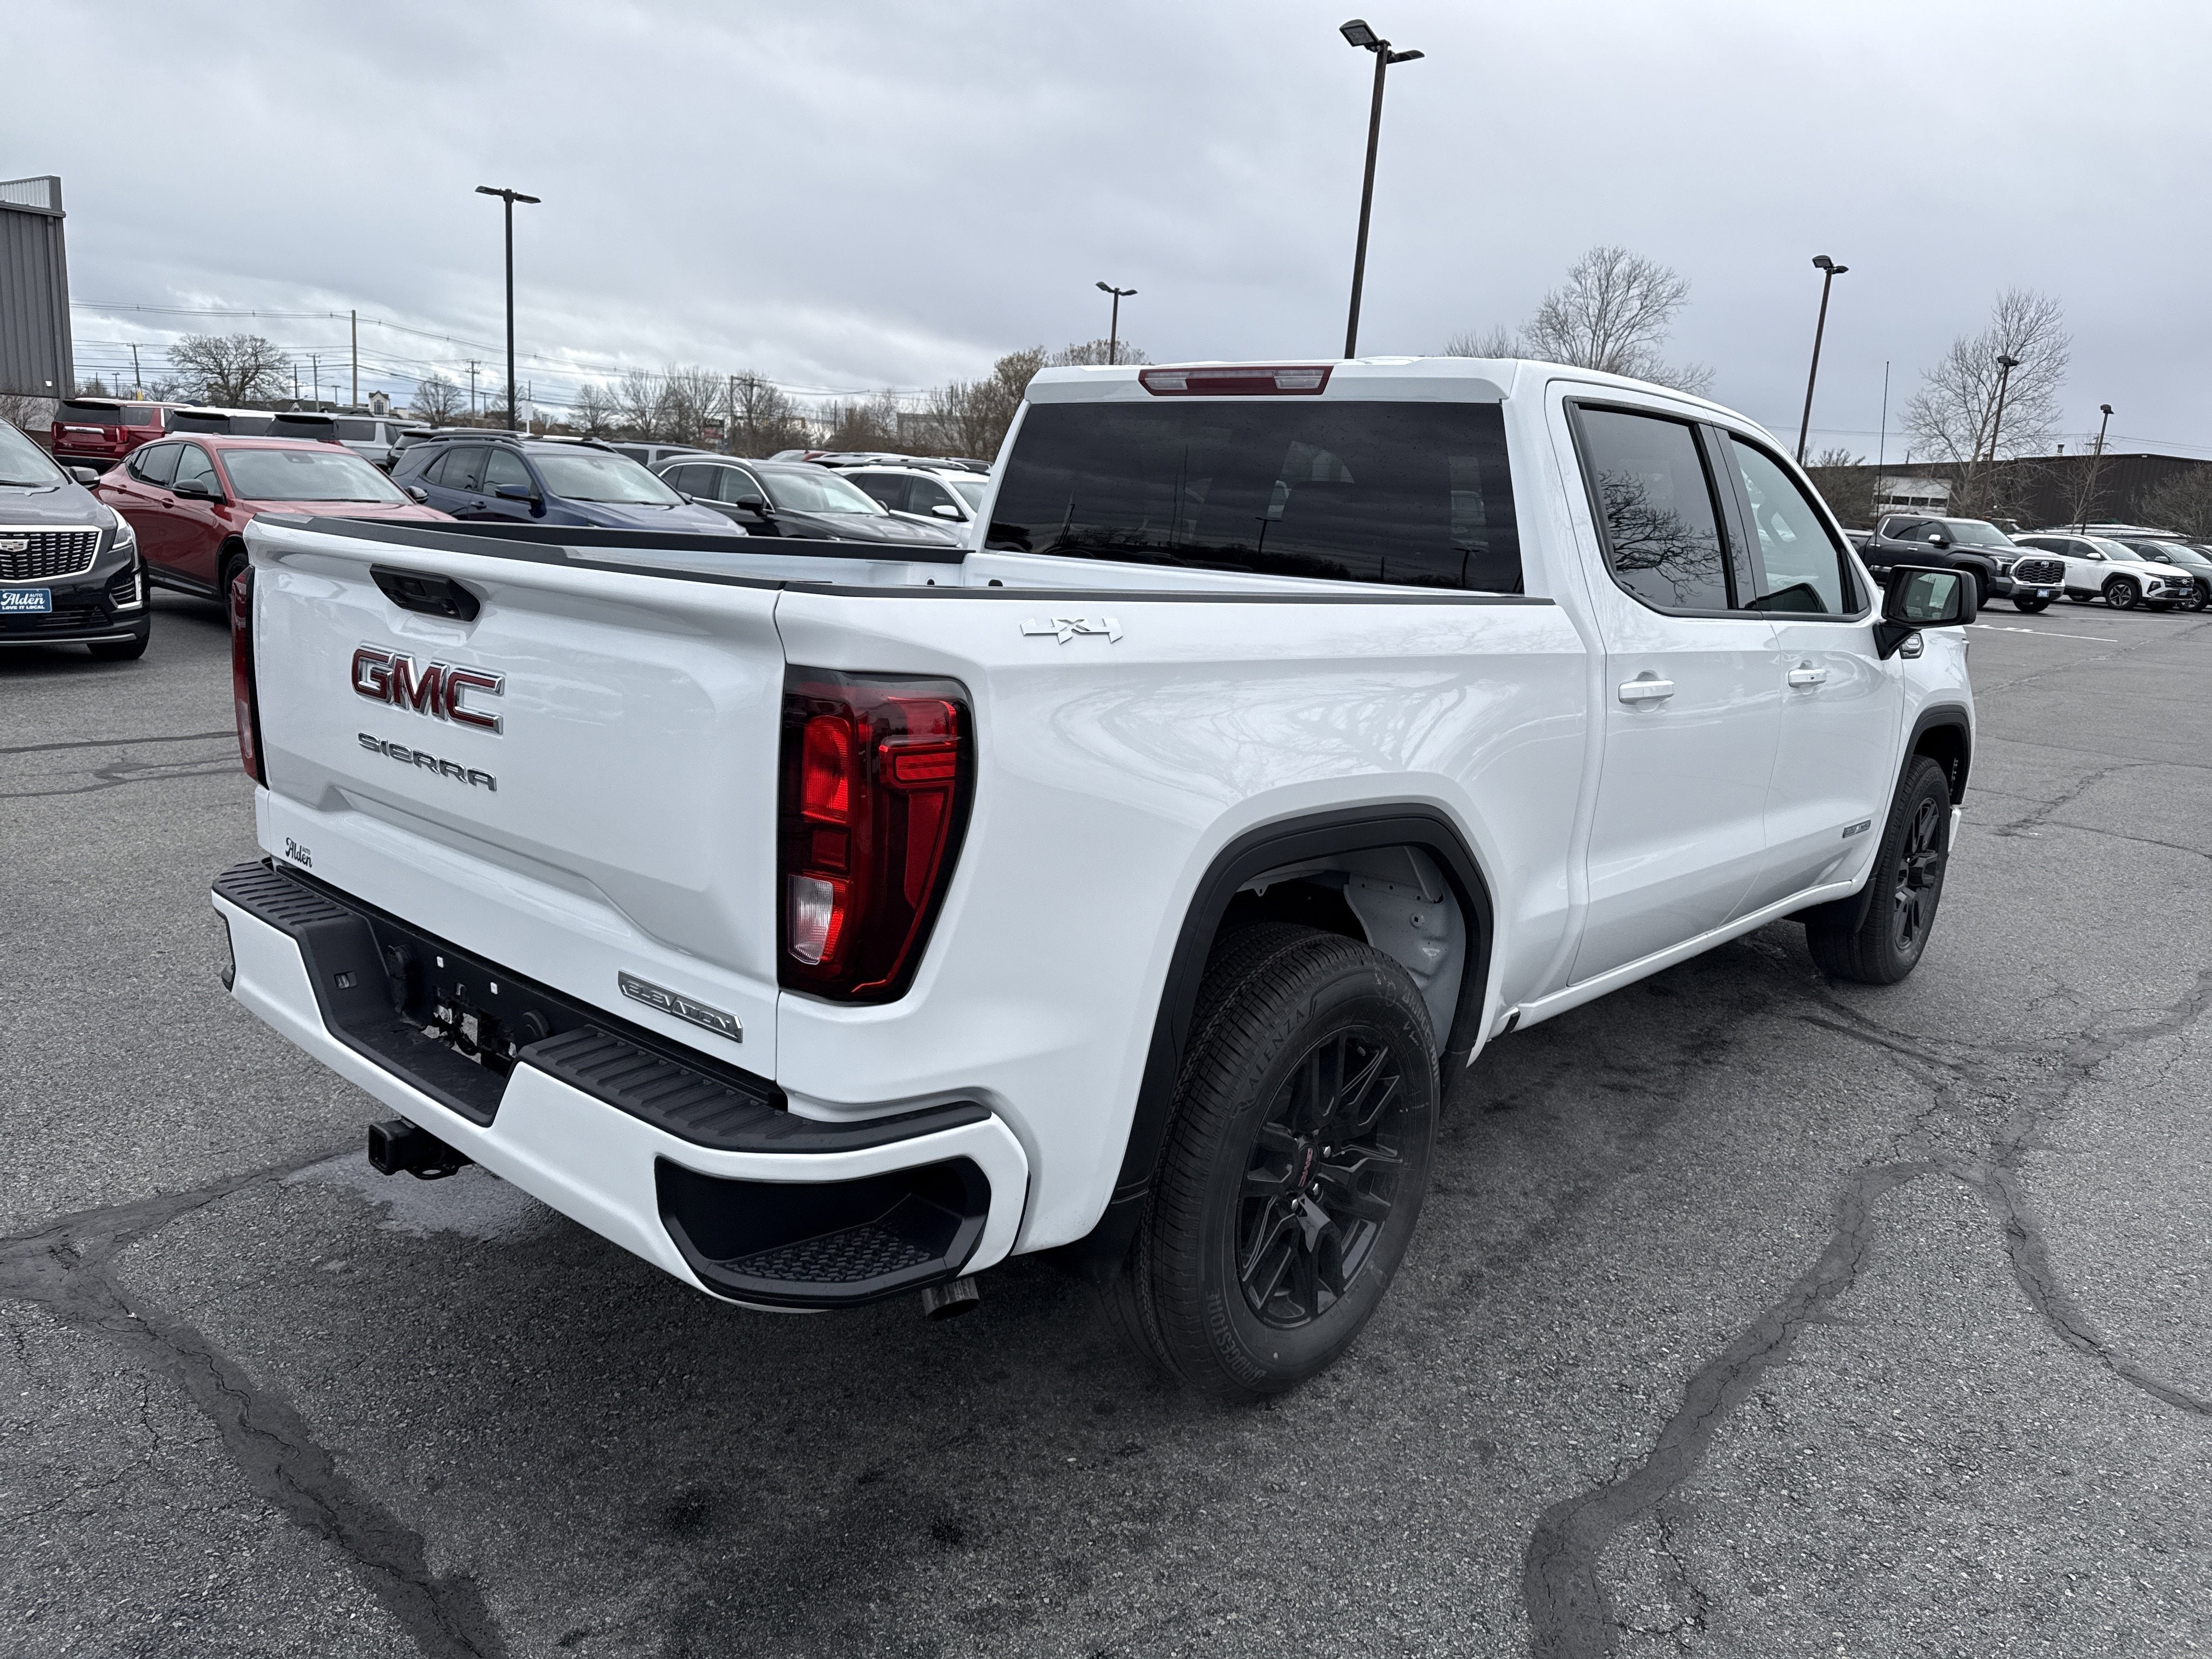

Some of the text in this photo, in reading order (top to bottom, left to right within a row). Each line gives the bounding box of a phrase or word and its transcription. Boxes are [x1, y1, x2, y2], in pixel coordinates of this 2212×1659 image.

[1, 592, 45, 605] Alden
[352, 644, 504, 735] GMC
[358, 732, 496, 791] SIERRA
[285, 837, 313, 868] Alden
[626, 979, 731, 1031] ELEVATION
[1248, 1008, 1306, 1093] ALENZA
[1297, 1148, 1313, 1187] GMC
